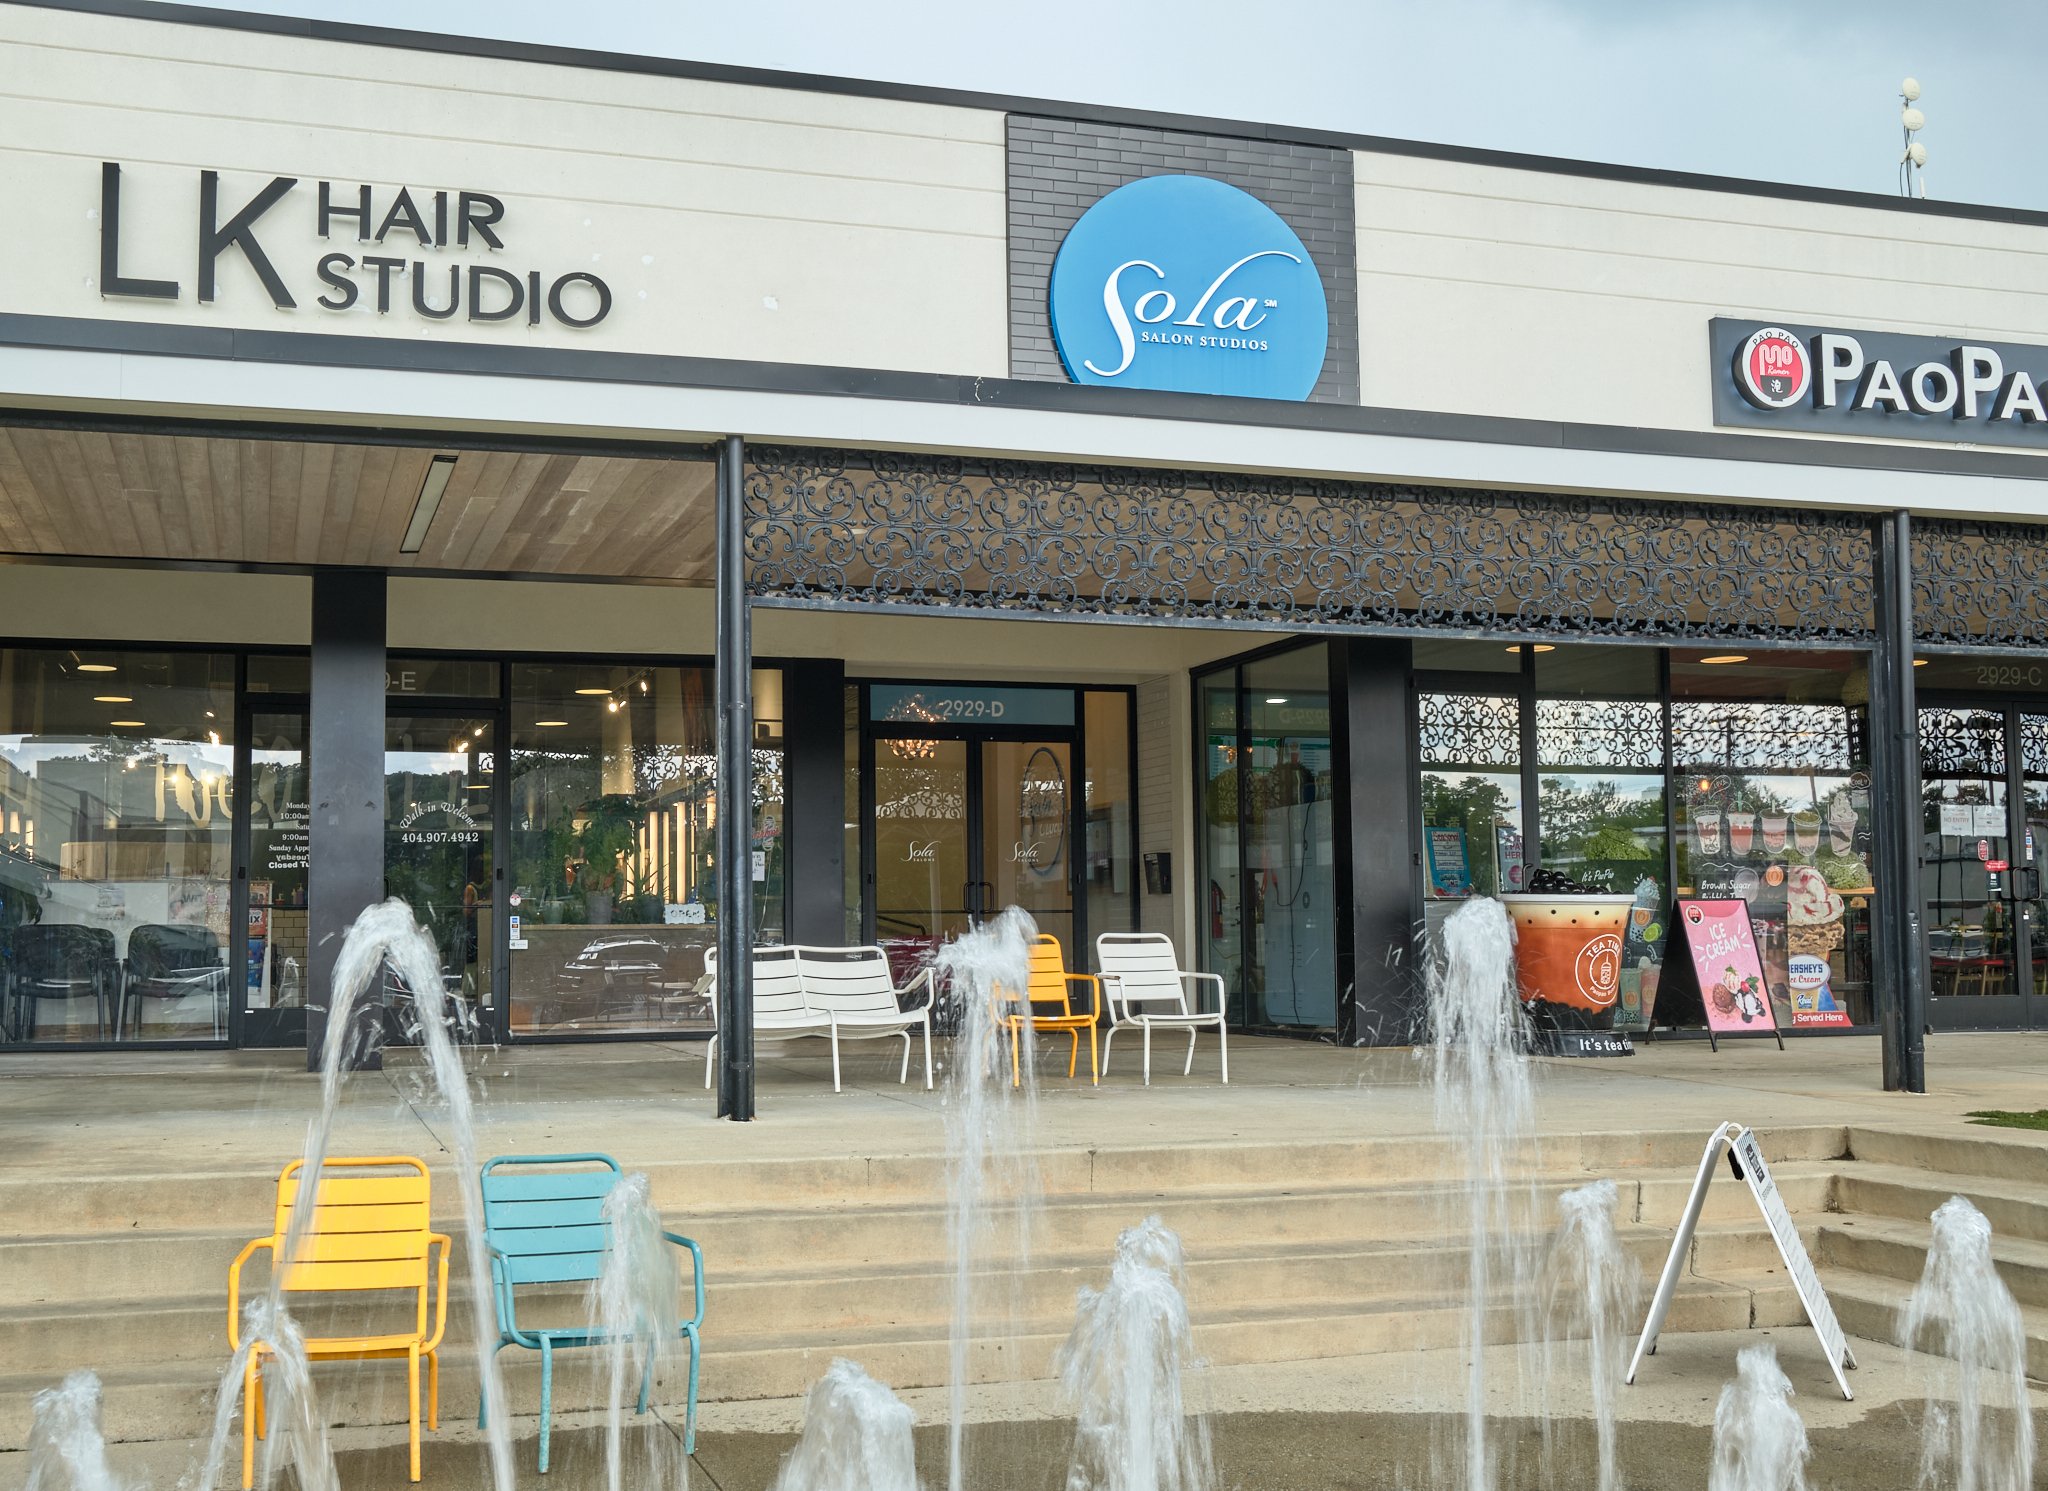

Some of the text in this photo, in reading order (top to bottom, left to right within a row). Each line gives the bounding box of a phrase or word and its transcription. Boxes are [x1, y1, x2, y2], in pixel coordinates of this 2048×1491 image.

[317, 180, 505, 250] HAIR
[101, 161, 298, 310] LK
[316, 252, 613, 329] STUDIO
[1083, 250, 1302, 377] Sola
[1141, 331, 1269, 352] SALON STUDIOS
[1752, 331, 1799, 348] PAO PAO
[1976, 665, 2042, 686] 2929-C
[943, 699, 1005, 718] 2929-D
[400, 801, 477, 829] Walk-in Welcome
[401, 832, 479, 843] 404.907.4942
[268, 844, 292, 852] Sunday
[900, 840, 942, 862] Sola
[1005, 841, 1046, 862] Sola
[268, 861, 298, 869] Closed
[1701, 879, 1752, 893] Brown Sugar
[1708, 922, 1727, 941] ICE
[1586, 941, 1606, 958] TEA
[1705, 934, 1742, 960] CREAM
[1790, 963, 1823, 974] ERSHEY'S
[1798, 975, 1822, 984] Cream
[1797, 1013, 1824, 1022] Served
[1824, 1013, 1844, 1022] Here
[1579, 1038, 1602, 1051] It's
